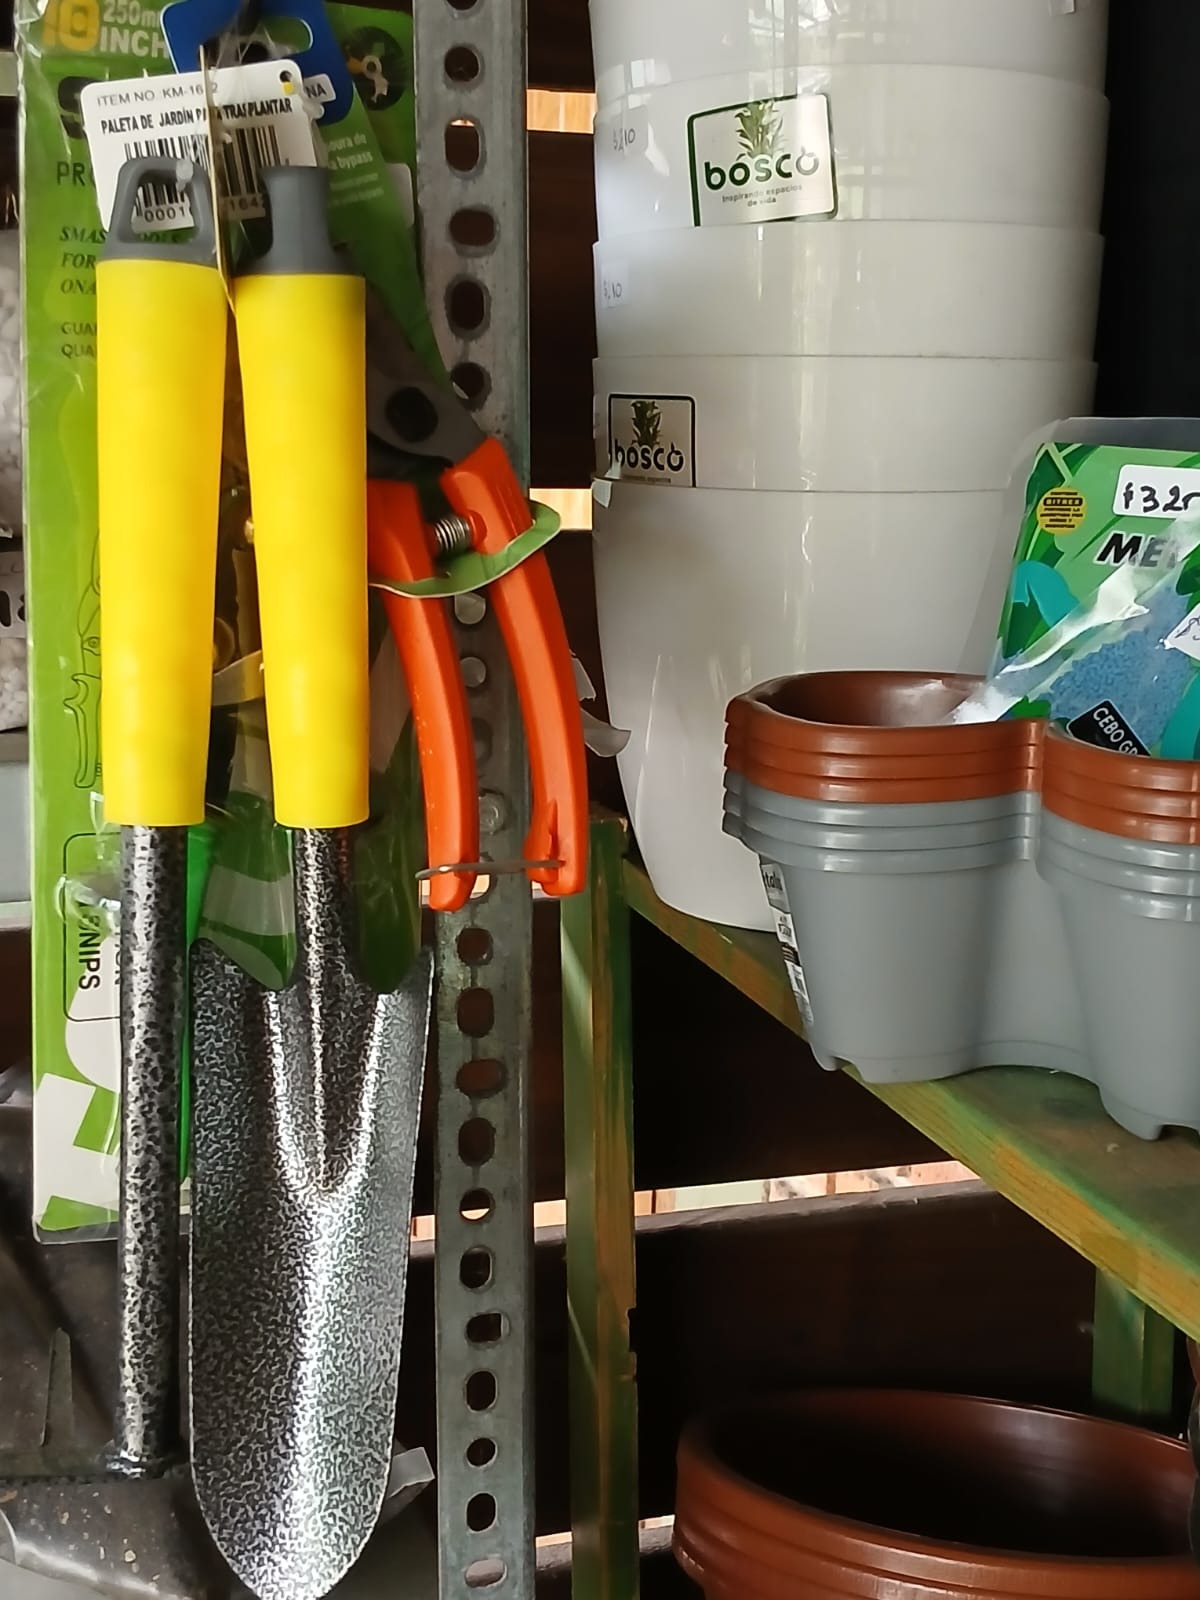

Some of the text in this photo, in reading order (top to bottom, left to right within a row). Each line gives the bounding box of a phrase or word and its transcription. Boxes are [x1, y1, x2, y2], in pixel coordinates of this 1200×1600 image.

[100, 26, 170, 59] INCH
[96, 82, 218, 107] ITEM NO KM-162
[101, 116, 139, 134] PALETA
[140, 114, 154, 129] DE
[159, 106, 194, 127] JARDÍN
[222, 98, 292, 119] TRASPLANTAR
[1092, 707, 1125, 743] CEBO
